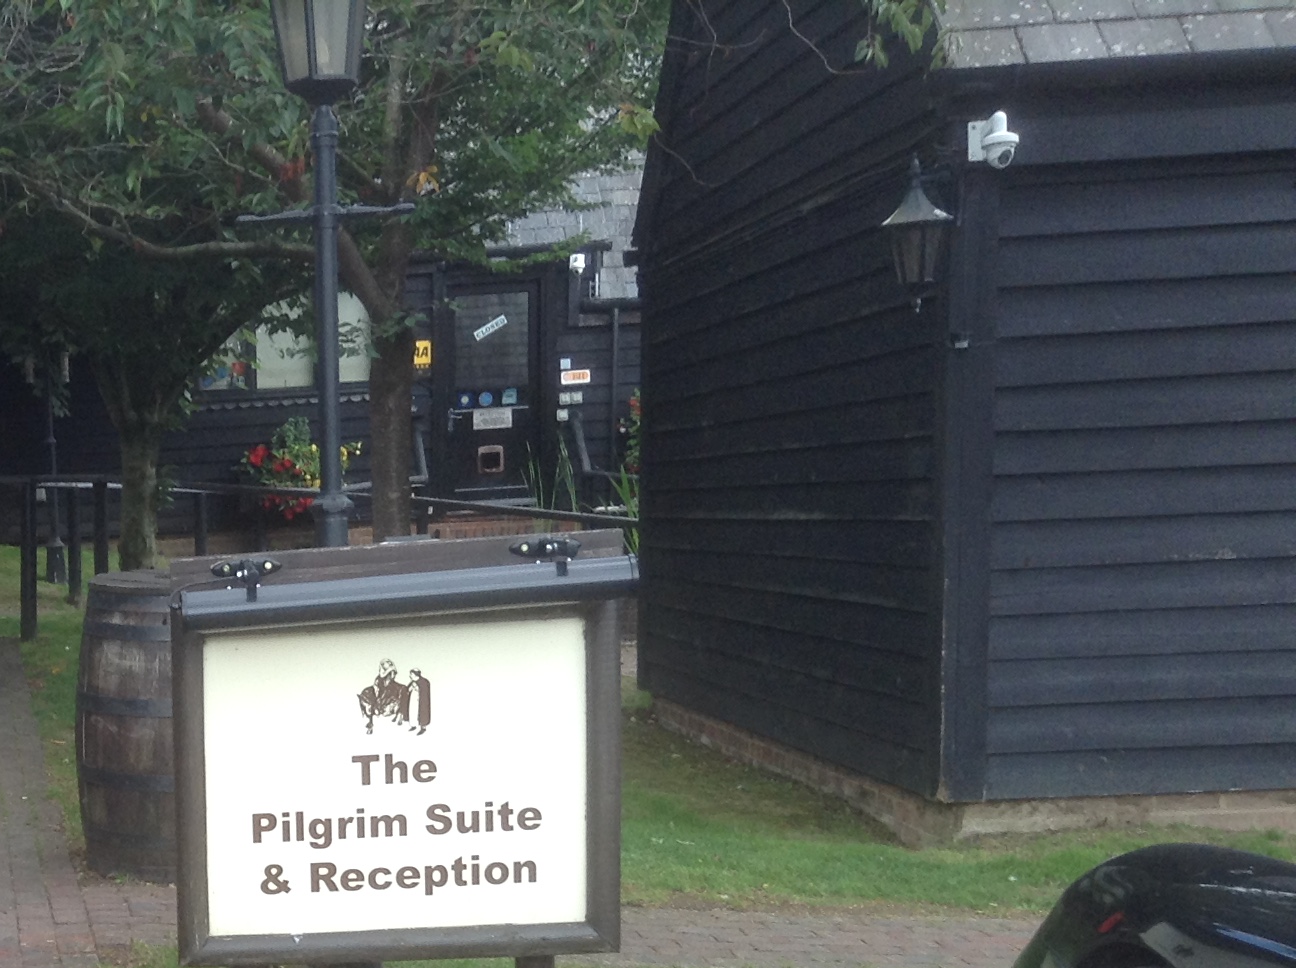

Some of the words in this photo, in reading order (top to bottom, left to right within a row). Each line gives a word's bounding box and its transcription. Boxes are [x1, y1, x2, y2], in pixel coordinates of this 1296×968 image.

[475, 316, 506, 339] CLOSED
[352, 754, 437, 785] The
[253, 809, 407, 848] Pilgrim
[426, 802, 542, 834] Suite
[261, 865, 291, 894] &
[311, 855, 536, 895] Reception
